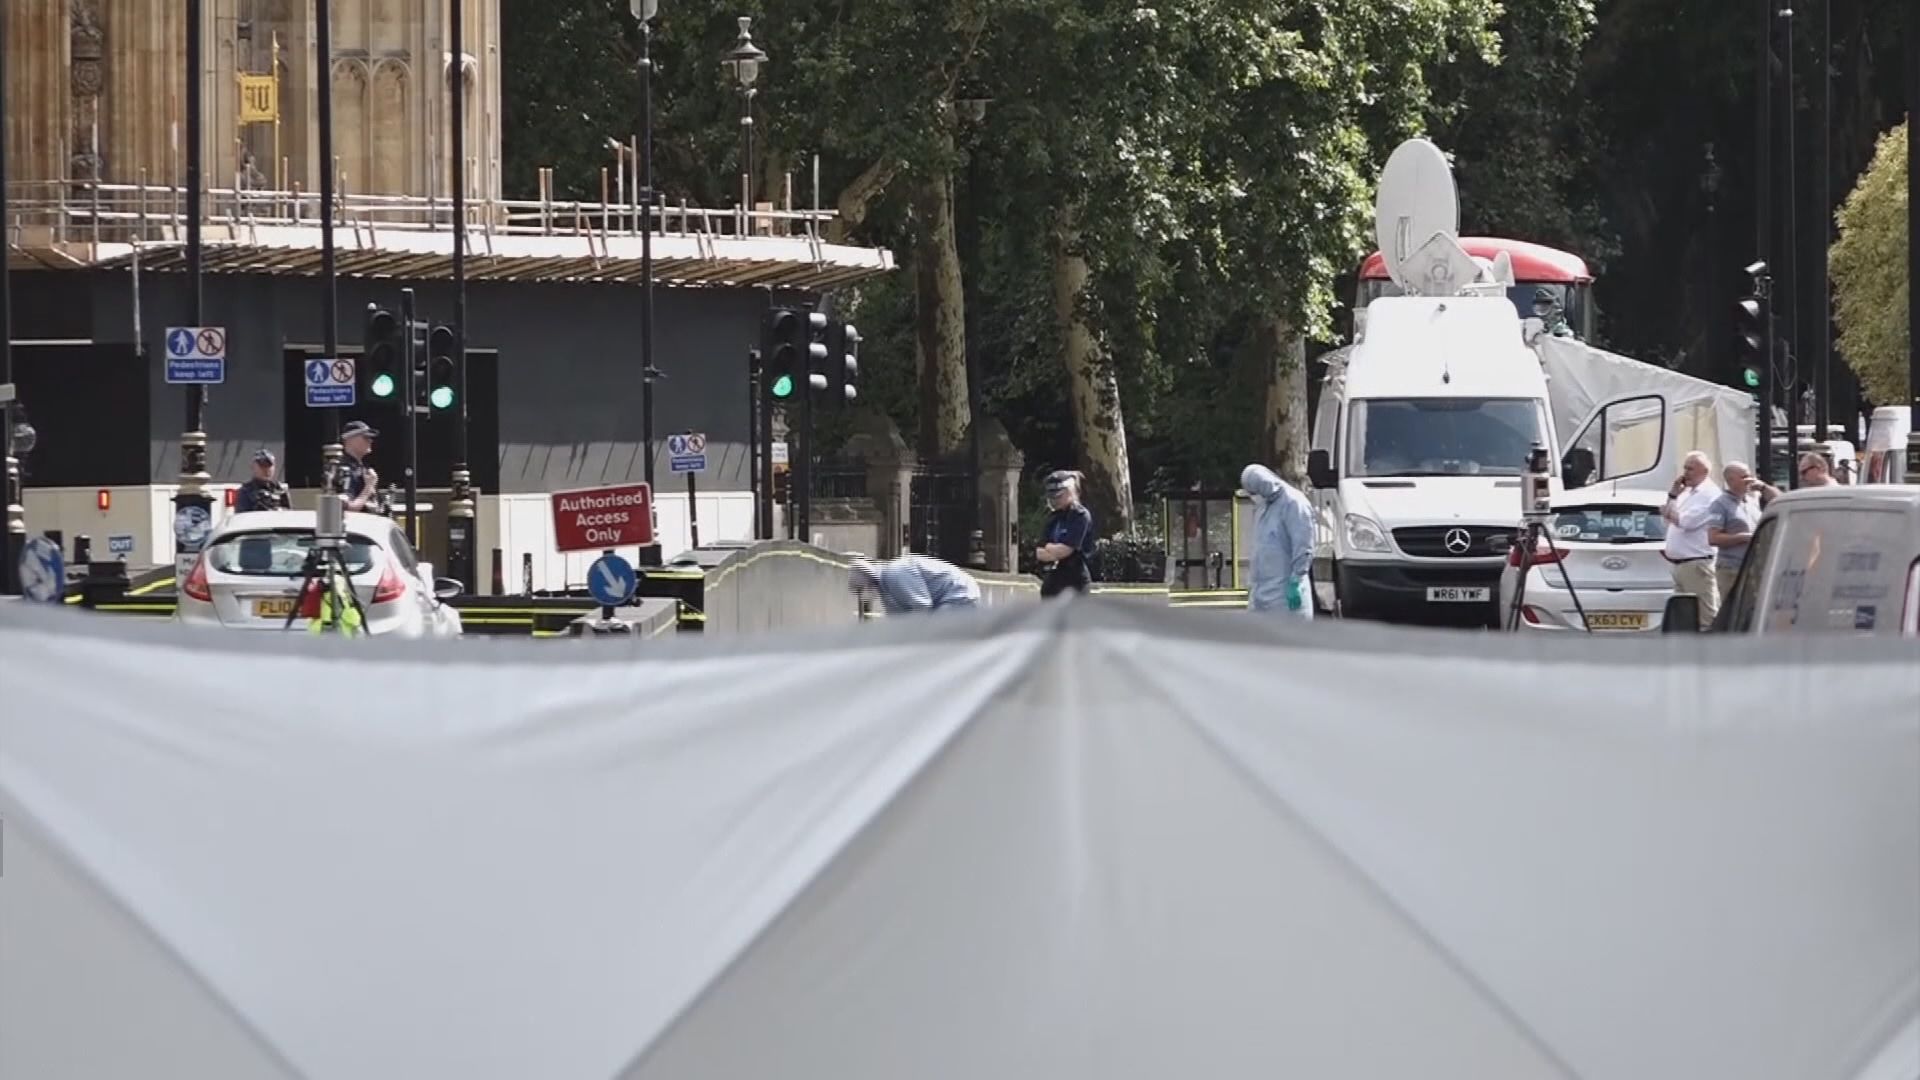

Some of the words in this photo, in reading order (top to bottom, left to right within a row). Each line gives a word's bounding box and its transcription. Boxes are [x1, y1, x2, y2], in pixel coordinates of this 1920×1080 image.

[169, 361, 220, 370] Pedestrians
[174, 370, 196, 379] keep
[198, 369, 215, 378] left
[309, 387, 351, 395] Pedestrians
[559, 491, 643, 512] Authorised
[576, 511, 630, 527] Access
[585, 528, 622, 543] Only
[110, 540, 131, 551] OUT
[1433, 588, 1459, 600] WR61
[1461, 588, 1483, 600] YWF
